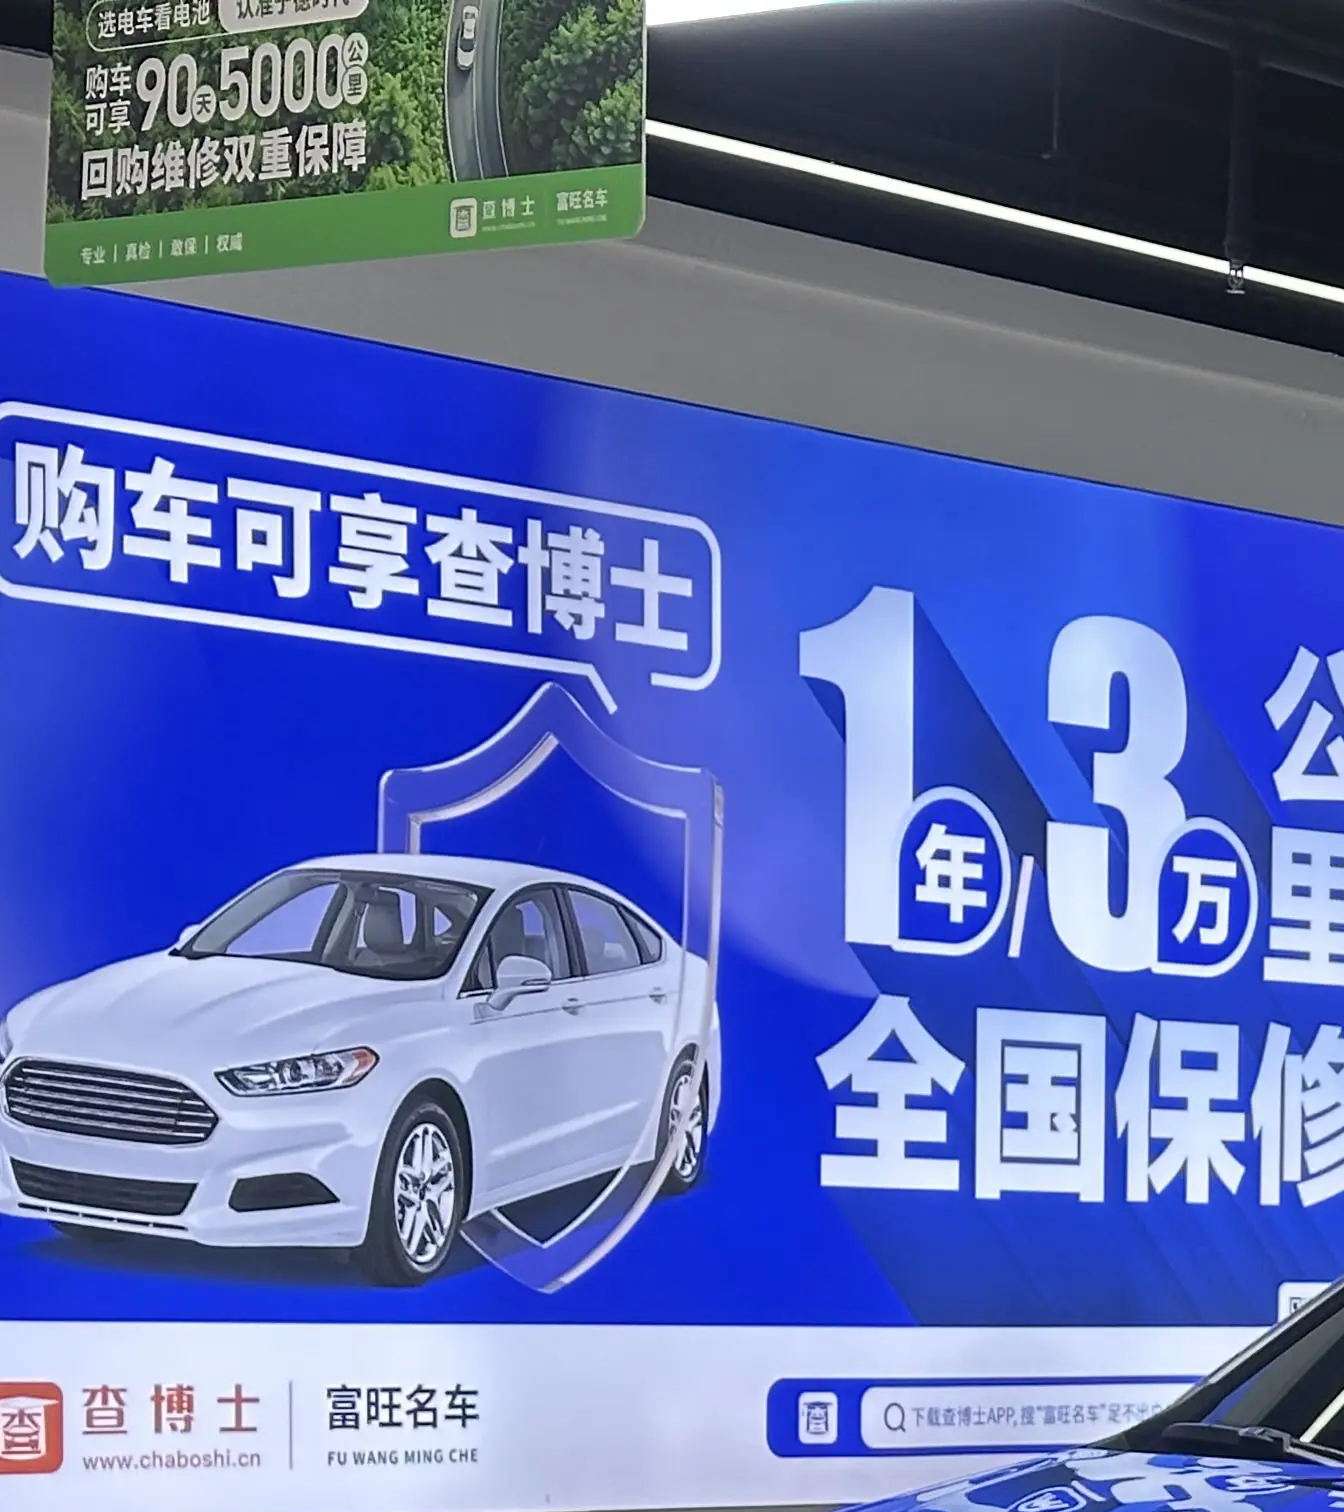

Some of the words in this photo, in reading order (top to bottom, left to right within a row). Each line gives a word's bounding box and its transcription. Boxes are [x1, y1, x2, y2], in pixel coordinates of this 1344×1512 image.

[97, 1, 211, 39] 选电车看电池
[85, 62, 132, 99] 购车
[85, 99, 131, 136] 可享
[81, 120, 367, 201] 回购维修双重保障
[13, 440, 696, 655] 购车可享查博士
[81, 1384, 261, 1435] 查博士
[326, 1383, 480, 1430] 富旺名车
[81, 1449, 262, 1471] www.chaboshi.cn
[327, 1452, 346, 1466] FU
[352, 1451, 399, 1466] WANG
[403, 1450, 444, 1465] MING
[448, 1448, 479, 1464] CHE
